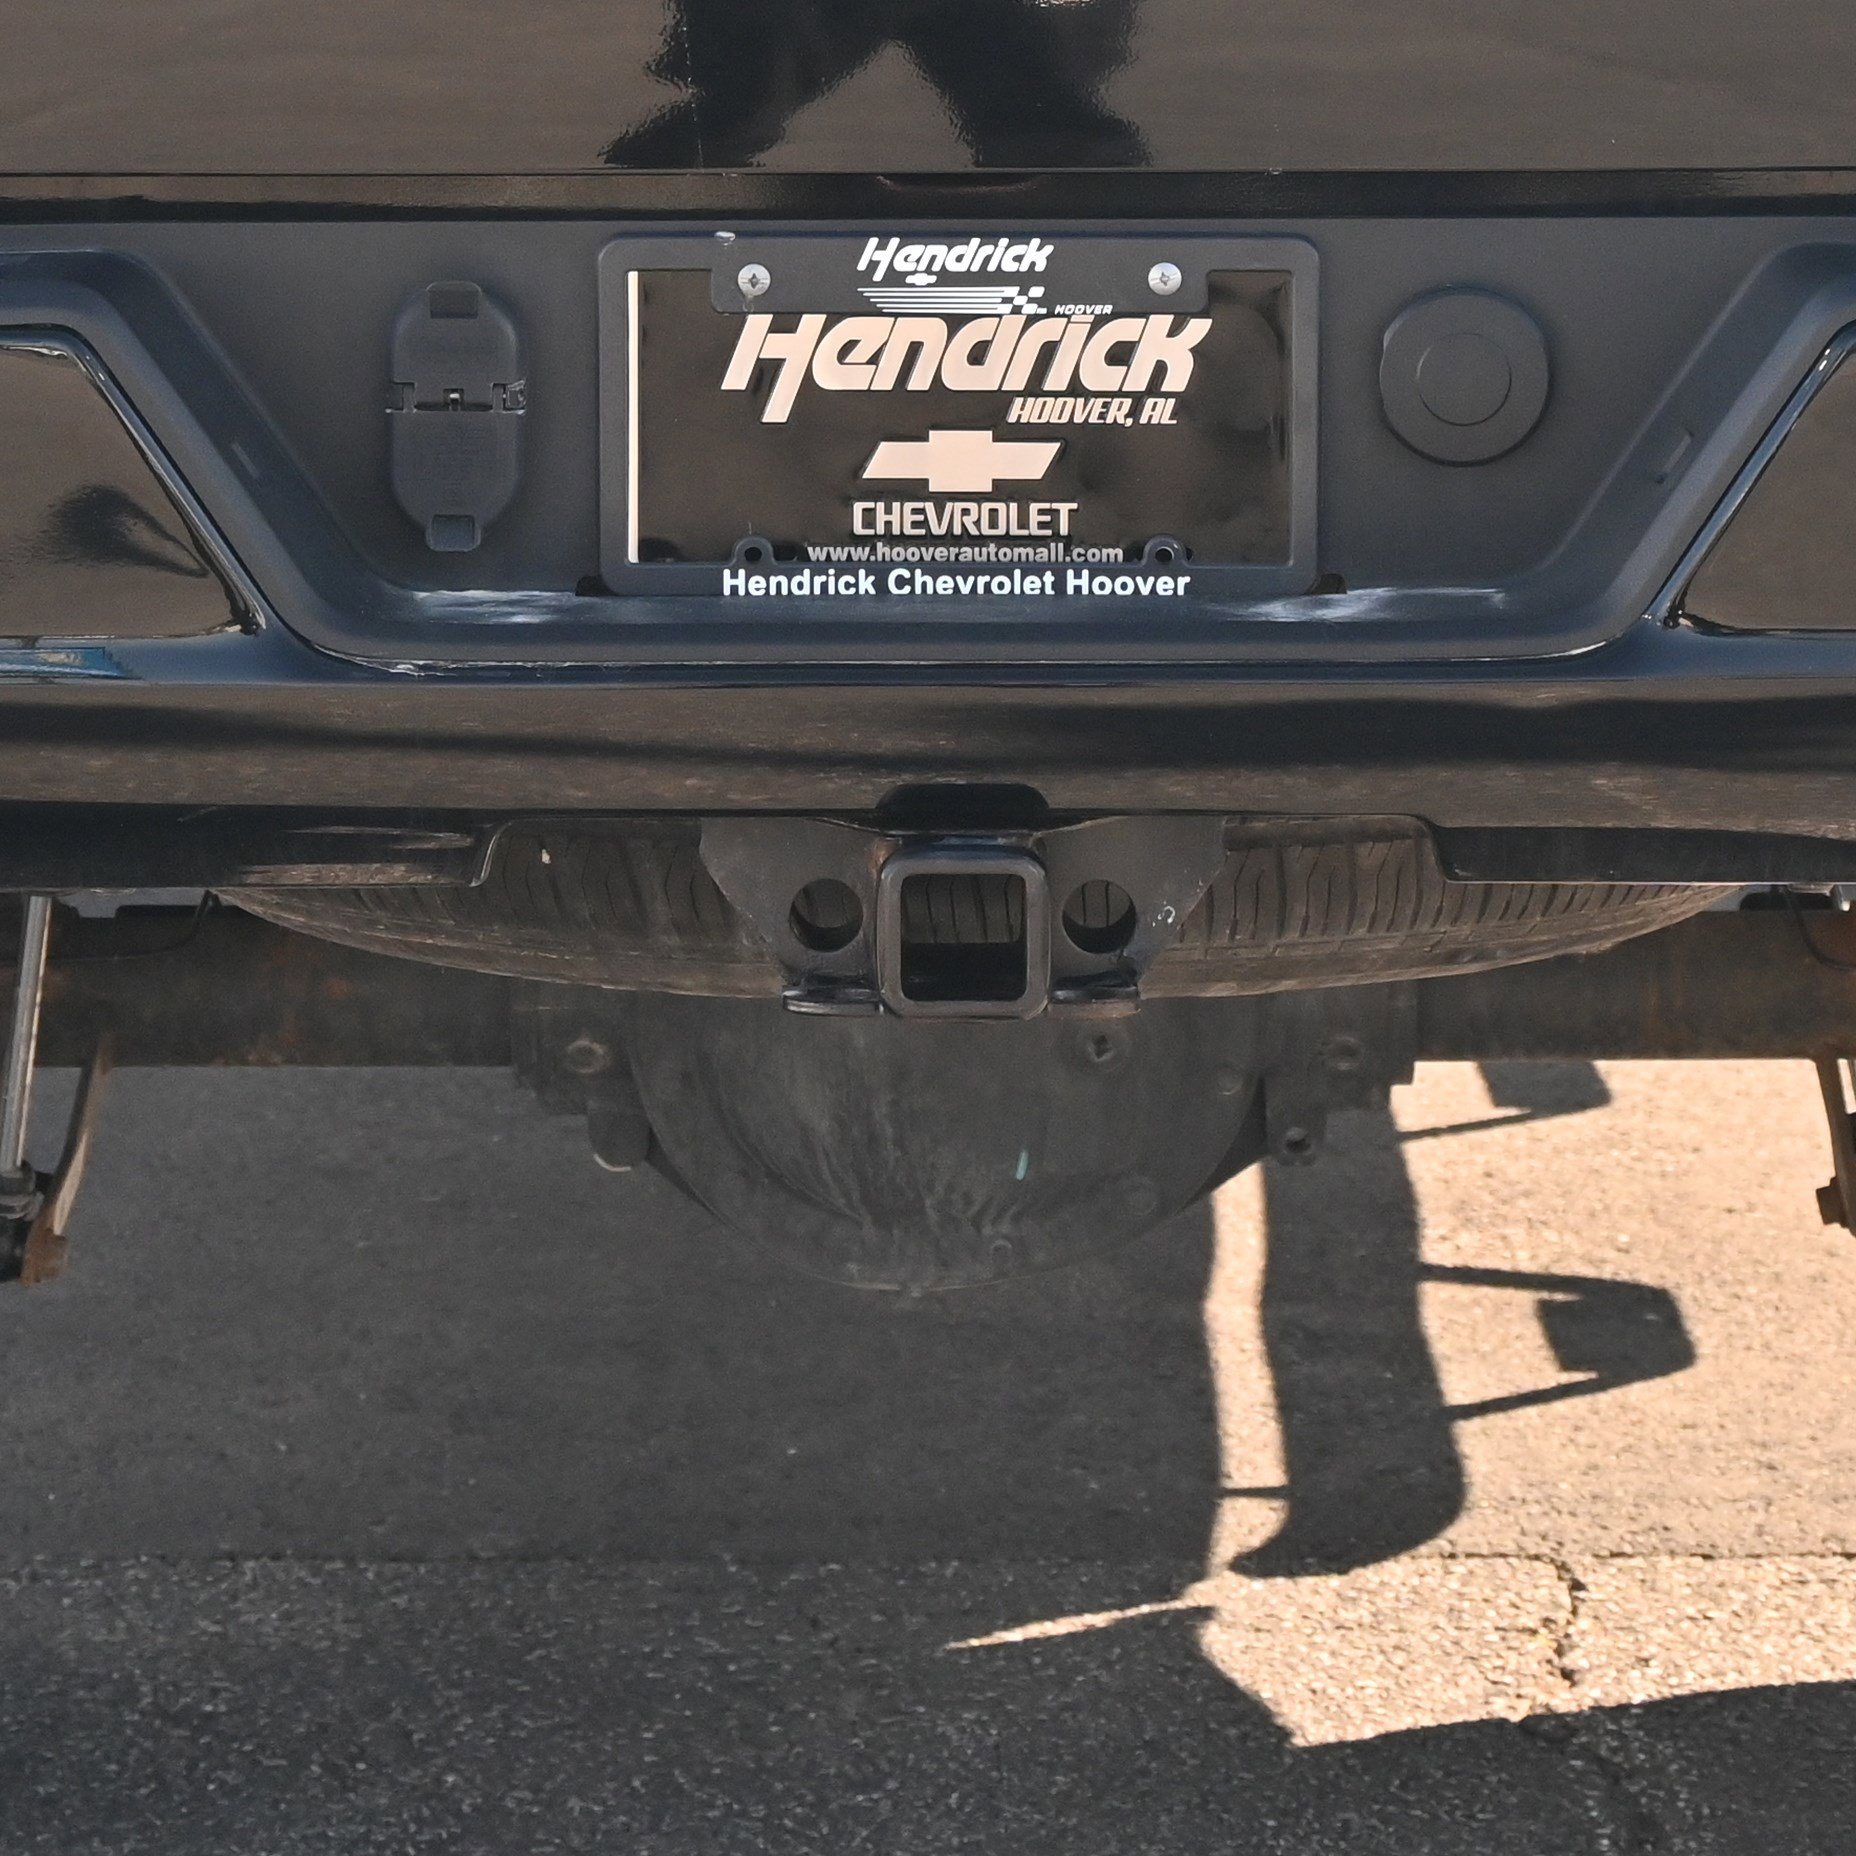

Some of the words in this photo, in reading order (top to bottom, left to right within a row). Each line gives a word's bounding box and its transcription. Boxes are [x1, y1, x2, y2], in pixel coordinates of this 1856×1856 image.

[856, 236, 1055, 282] Hendrick
[1054, 304, 1114, 316] HOOVER
[720, 314, 1213, 425] Hendrick
[1006, 396, 1134, 428] HOOVER,
[1139, 397, 1178, 425] AL
[852, 501, 1079, 537] CHEVROLET
[806, 542, 1125, 564] www.hooverautomall.com
[722, 568, 877, 597] Hendrick
[887, 567, 1056, 596] Chevrolet
[1066, 568, 1191, 596] Hoover
